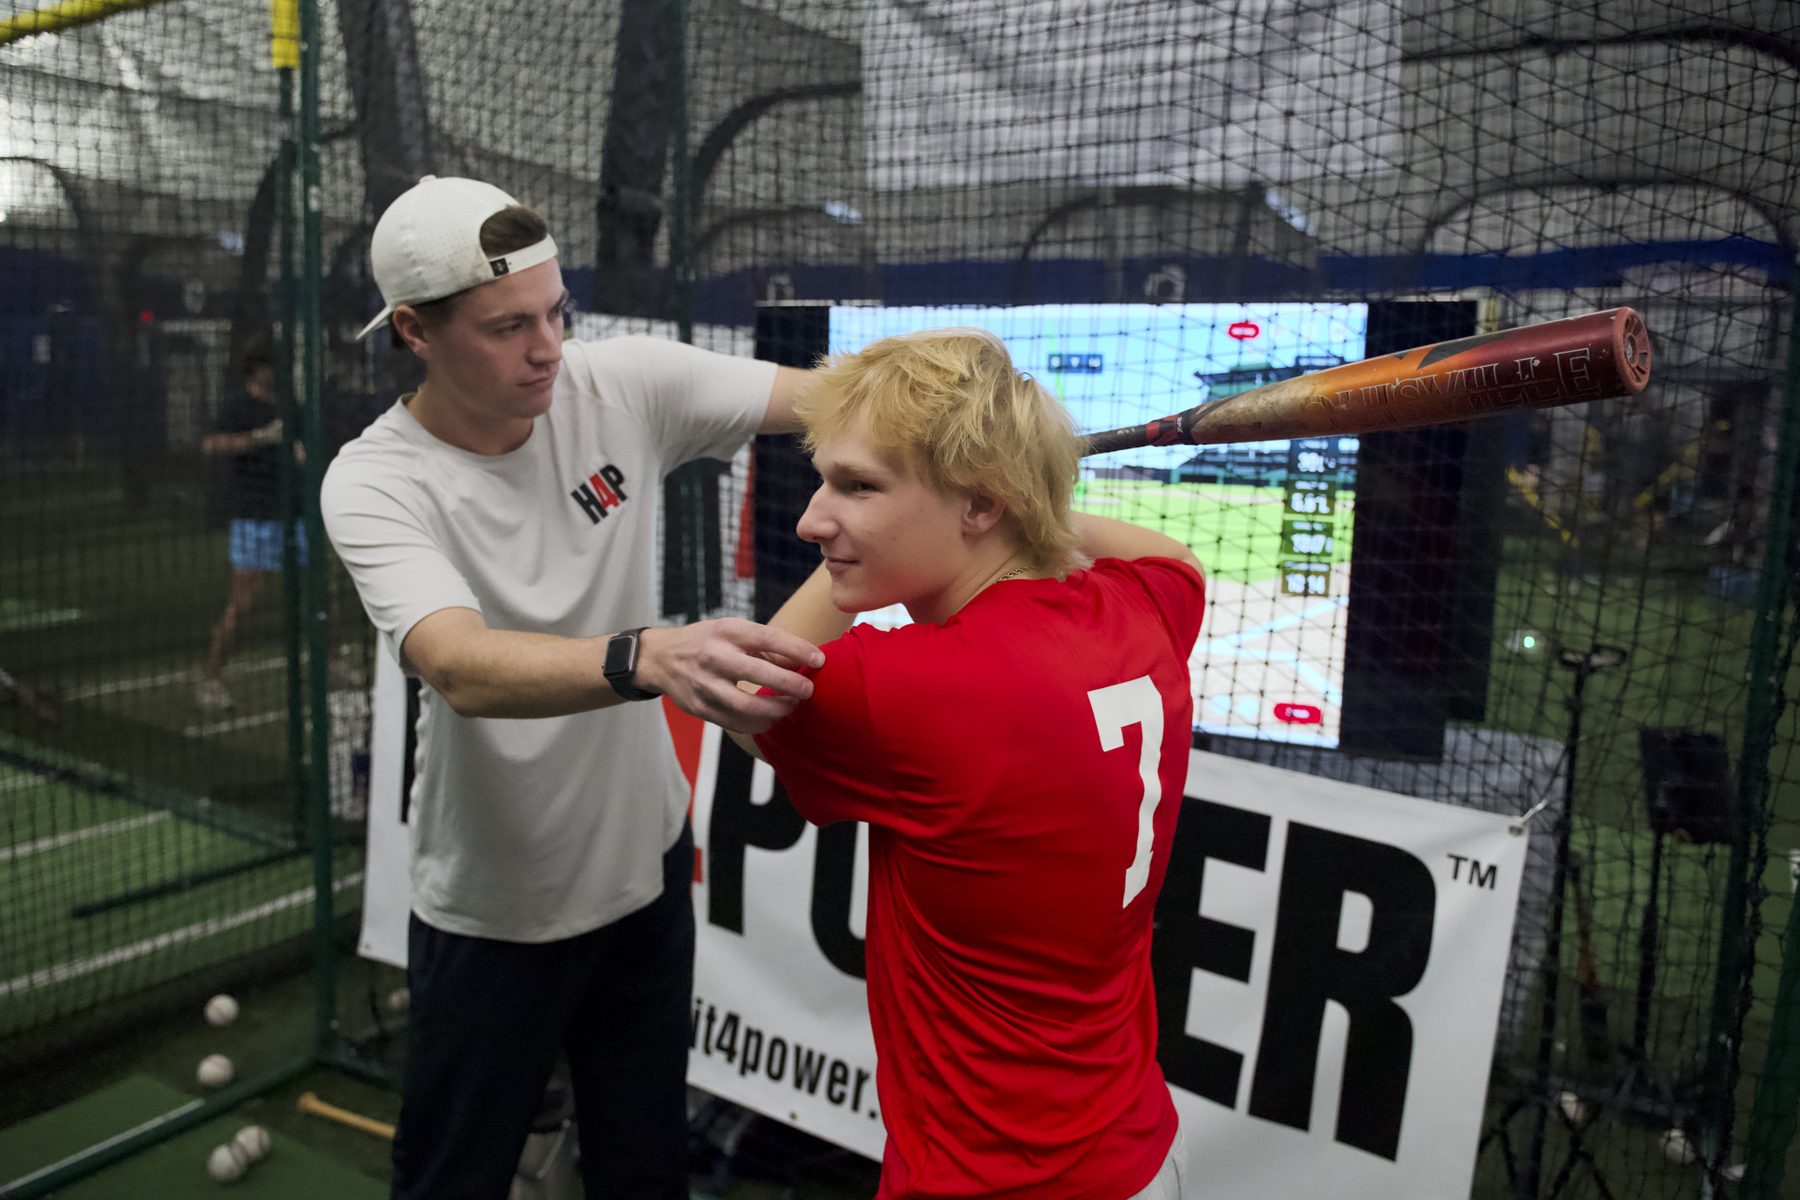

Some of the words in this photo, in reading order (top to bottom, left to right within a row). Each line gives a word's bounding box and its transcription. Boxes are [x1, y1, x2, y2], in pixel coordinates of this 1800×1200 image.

[571, 464, 627, 525] H4P
[1087, 675, 1164, 908] 7
[1447, 853, 1497, 889] TM
